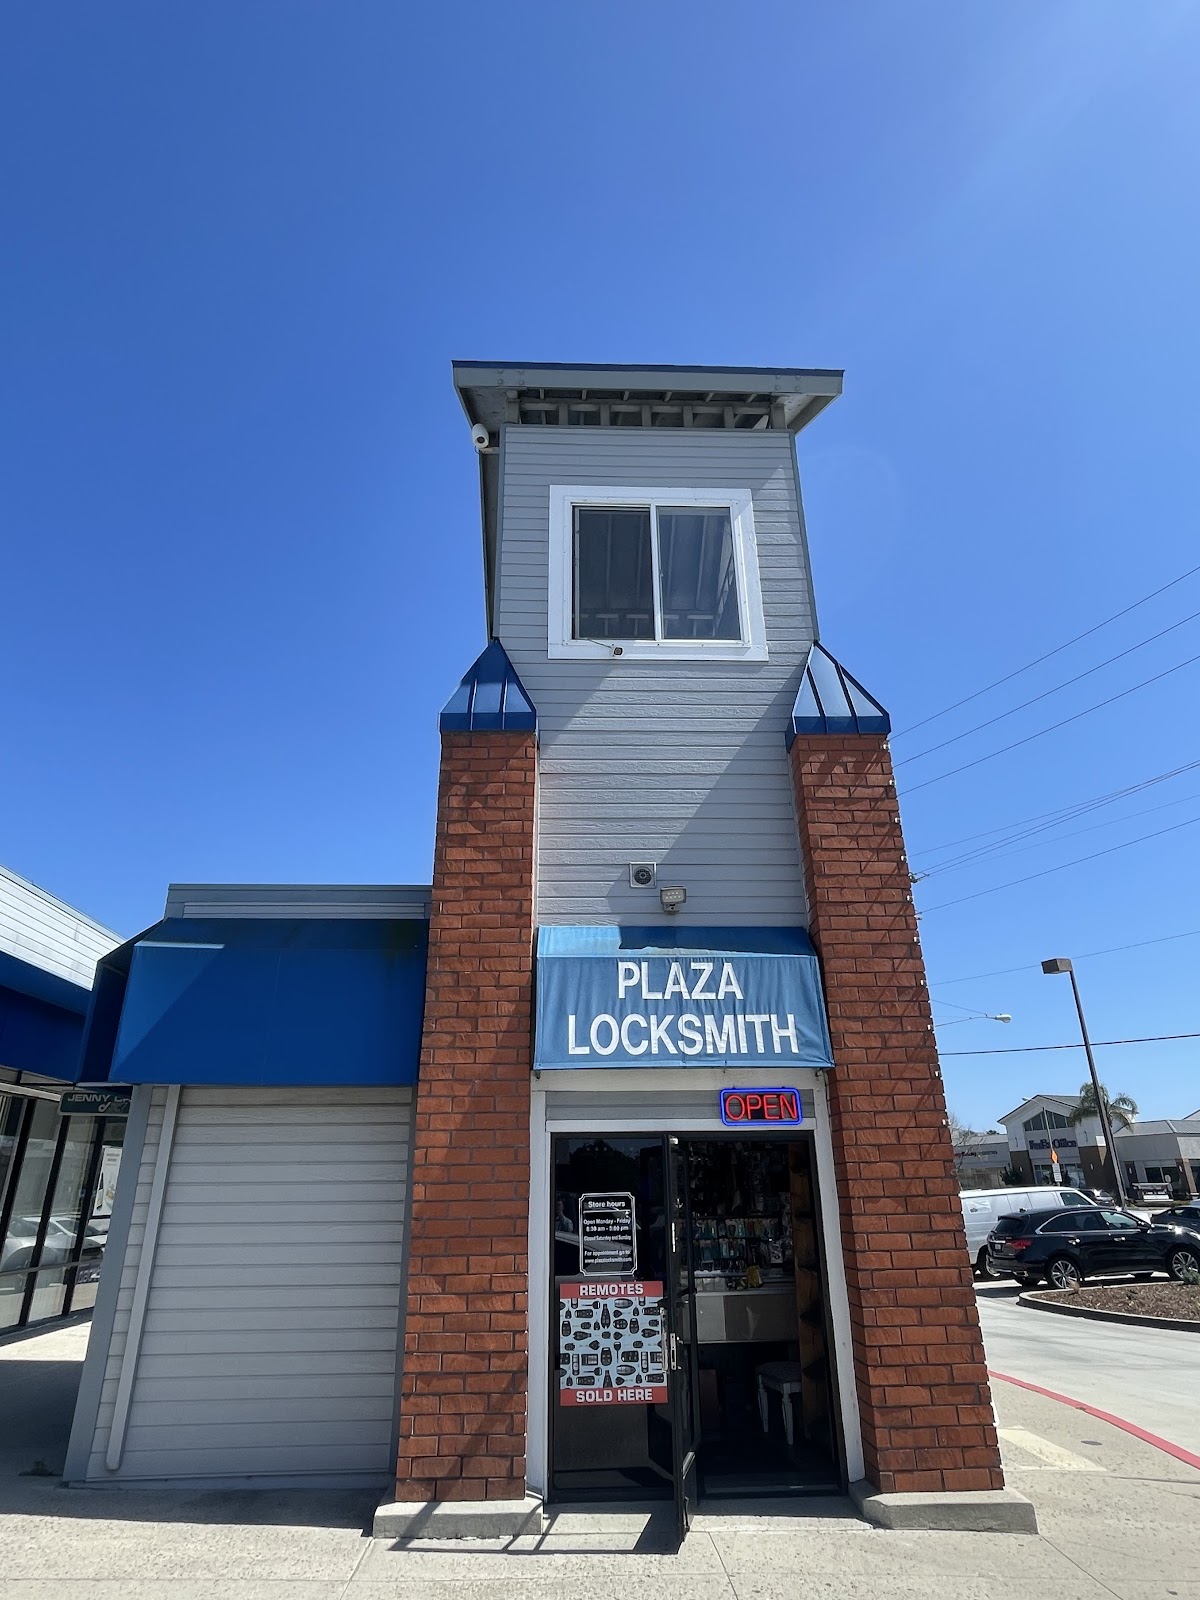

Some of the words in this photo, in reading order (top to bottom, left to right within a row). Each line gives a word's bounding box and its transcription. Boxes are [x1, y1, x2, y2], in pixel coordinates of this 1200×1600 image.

[618, 961, 744, 1000] PLAZA
[568, 1013, 799, 1056] LOCKSMITH
[68, 1094, 111, 1102] JENNY
[725, 1094, 798, 1121] OPEN
[580, 1284, 644, 1296] REMOTES
[576, 1389, 613, 1403] SOLD
[617, 1388, 653, 1402] HERE
